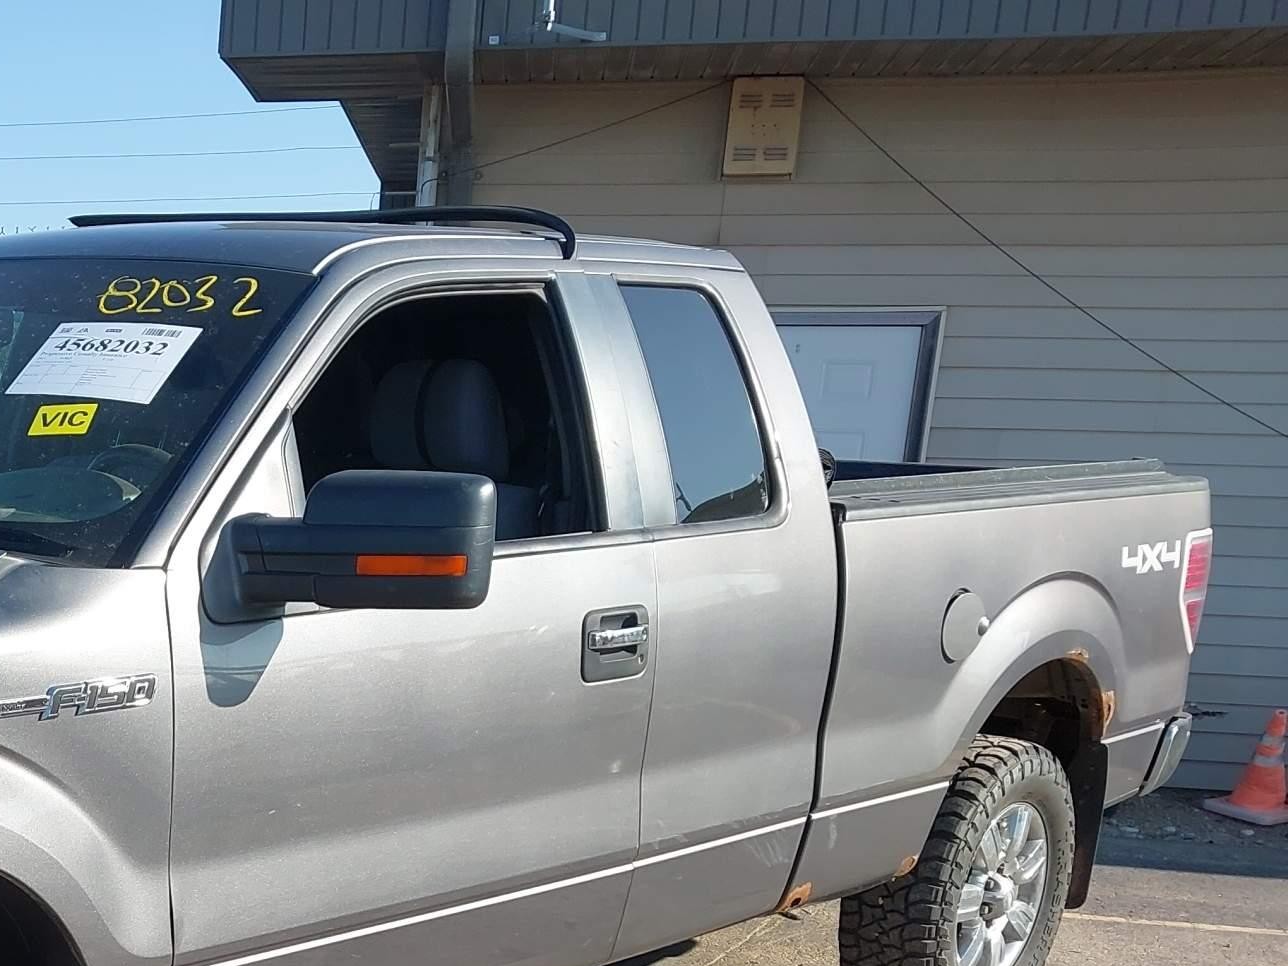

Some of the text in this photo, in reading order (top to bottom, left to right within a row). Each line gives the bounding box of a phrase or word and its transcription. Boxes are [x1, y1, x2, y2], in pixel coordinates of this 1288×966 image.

[97, 275, 263, 317] 82032
[54, 338, 169, 357] 45682032
[39, 410, 90, 429] VIC
[44, 674, 158, 717] F-150
